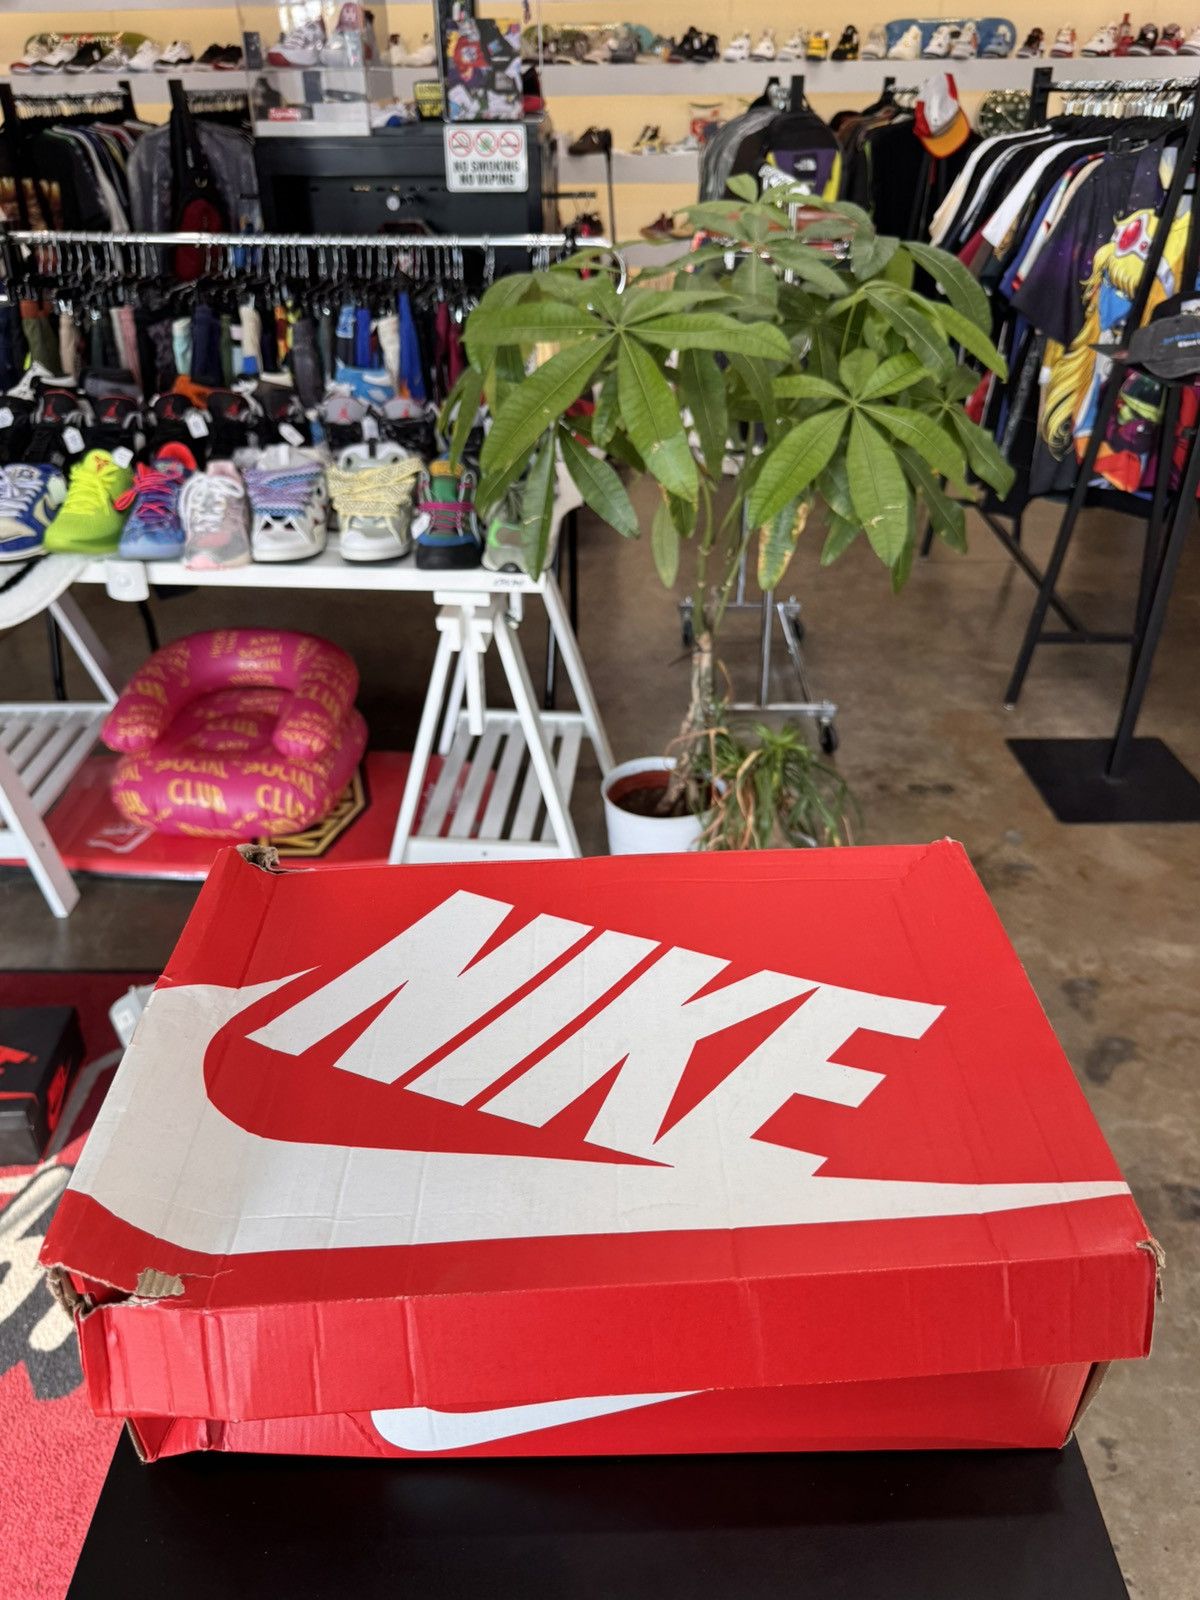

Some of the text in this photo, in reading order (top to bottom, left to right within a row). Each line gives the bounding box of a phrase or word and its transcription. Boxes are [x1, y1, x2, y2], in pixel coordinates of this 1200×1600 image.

[453, 161, 520, 172] NO SMOKING
[460, 174, 515, 185] NO VAPING
[245, 889, 946, 1176] NIKE
